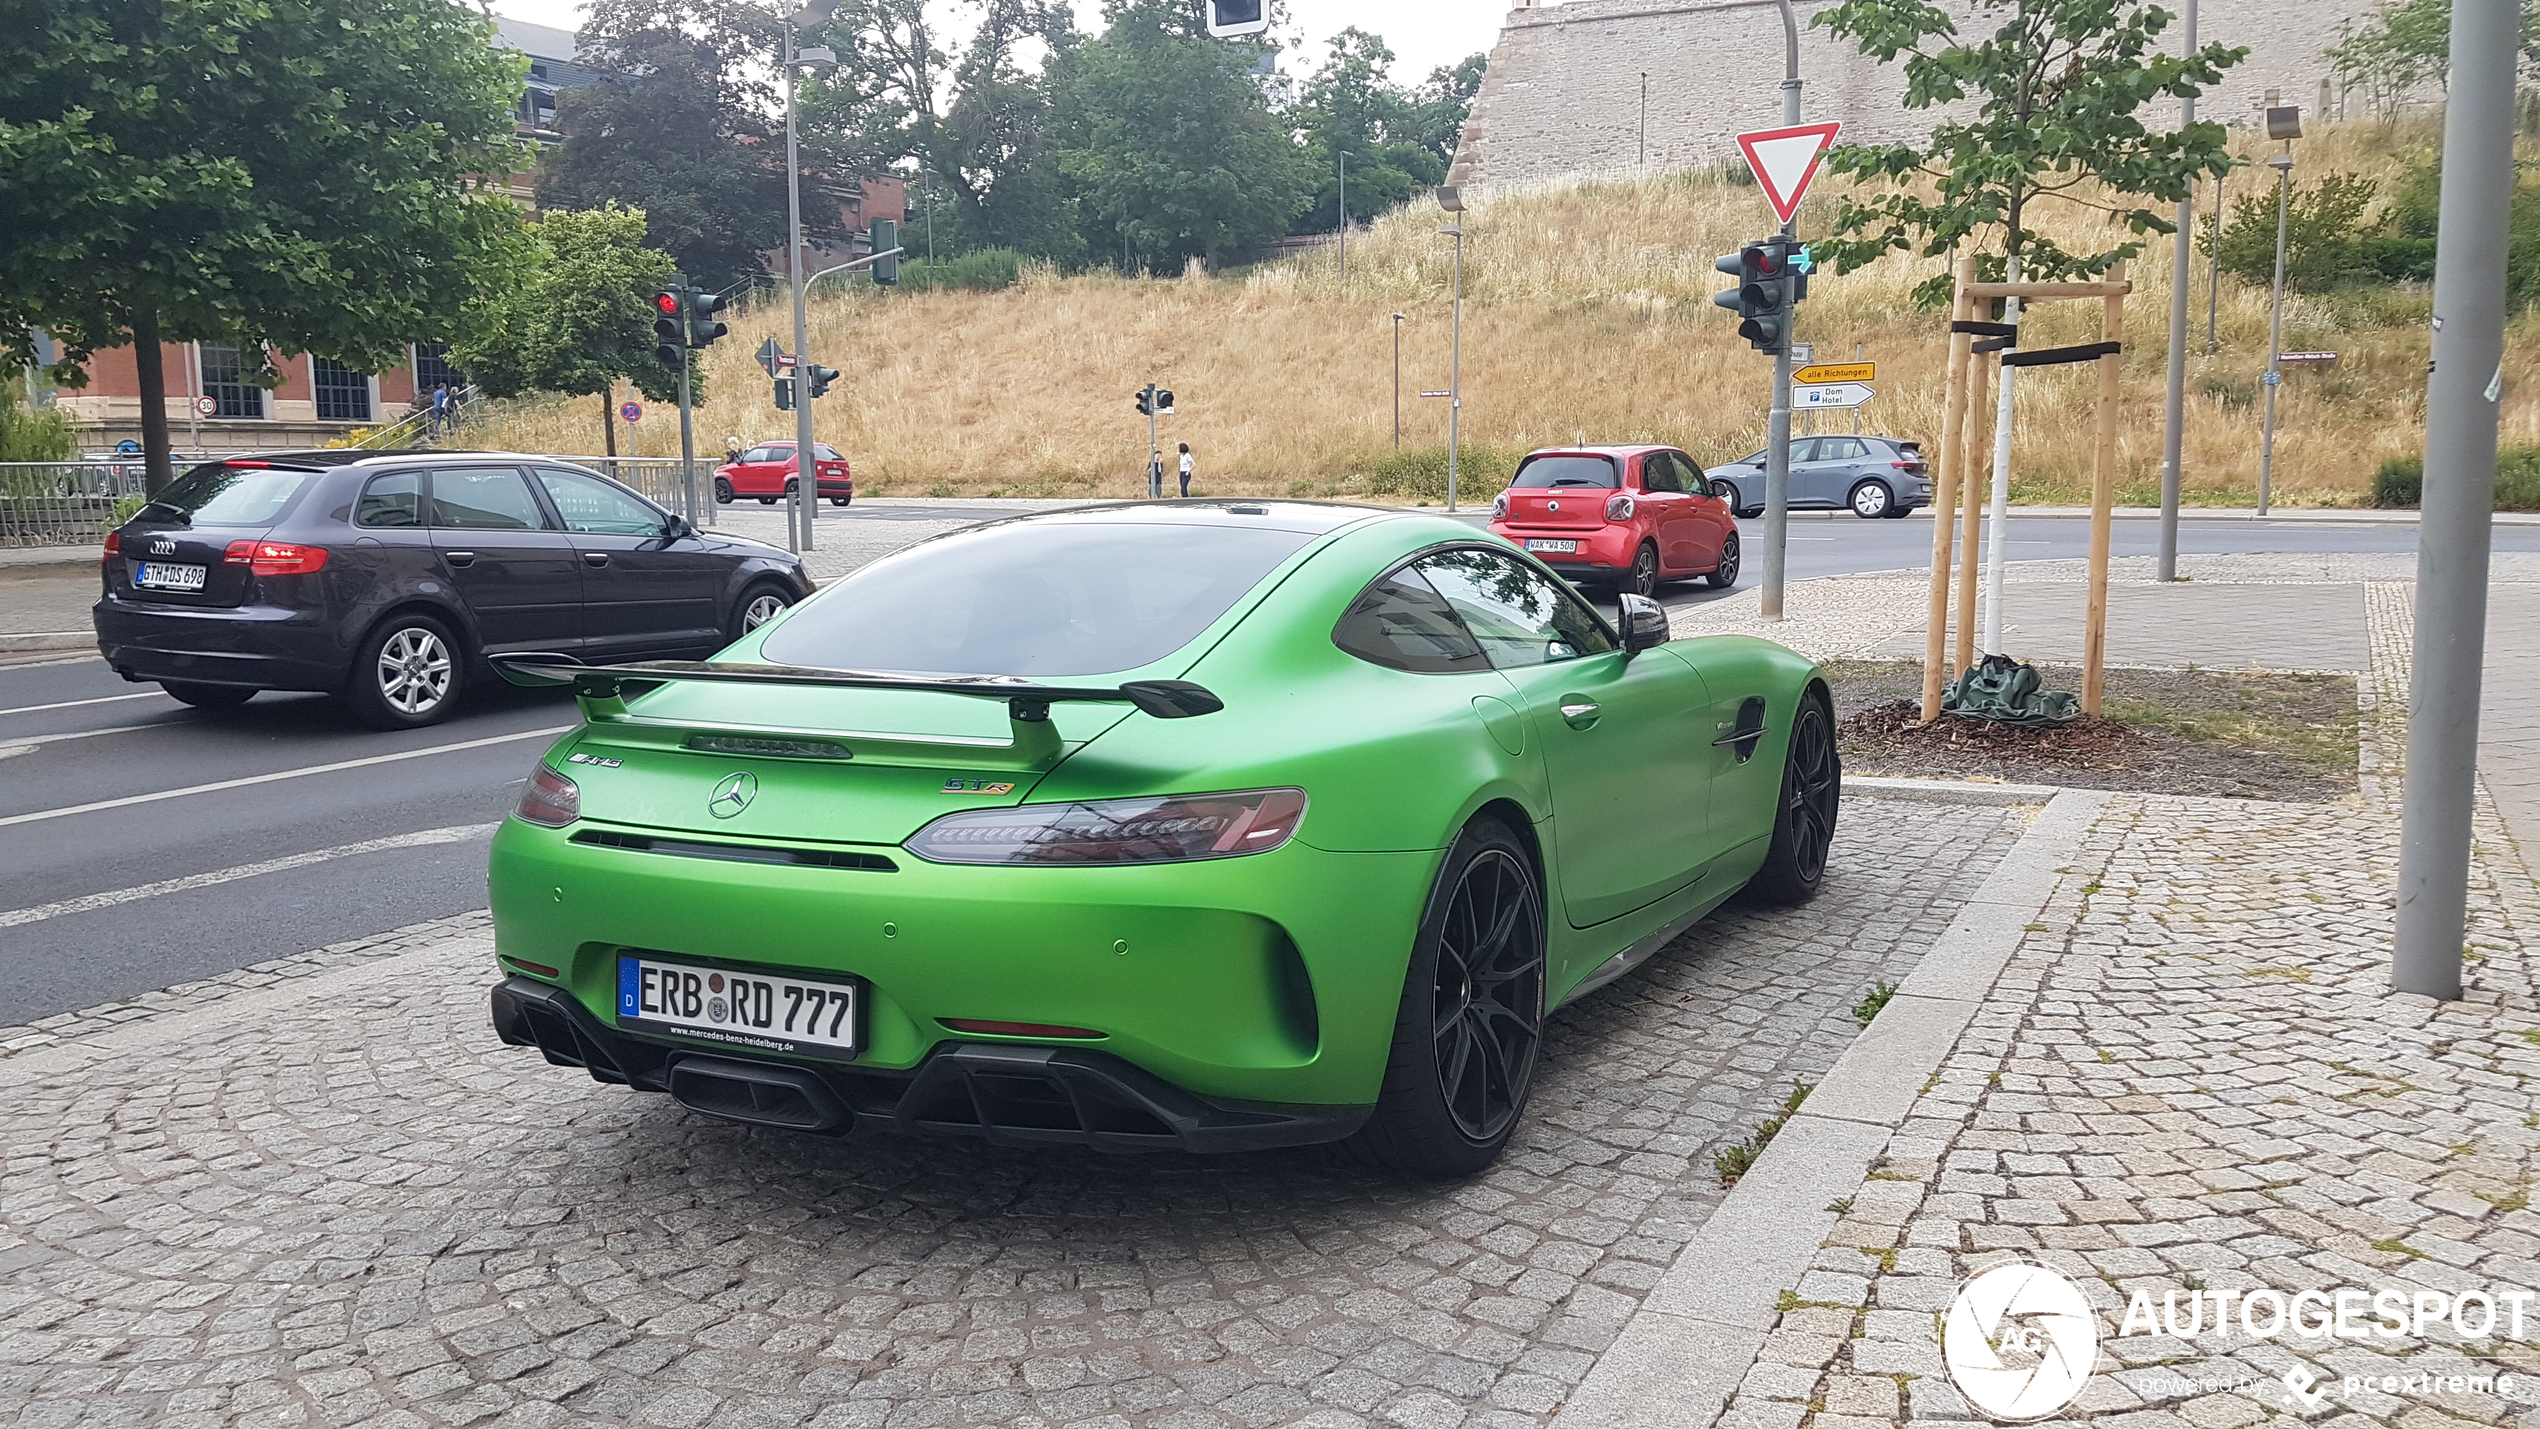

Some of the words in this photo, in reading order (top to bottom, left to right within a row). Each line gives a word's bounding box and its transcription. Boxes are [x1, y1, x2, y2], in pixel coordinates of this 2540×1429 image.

[1824, 369, 1868, 378] Richtungen
[201, 401, 212, 410] 30
[1560, 541, 1575, 550] 508
[144, 565, 163, 581] GTH
[168, 566, 182, 583] DS
[184, 568, 204, 584] 698
[625, 994, 633, 1007] D
[640, 966, 702, 1018] ERB
[730, 978, 773, 1029] RD
[784, 985, 850, 1038] 777
[670, 1025, 794, 1051] www.mercedes-benz-heidelberg.de
